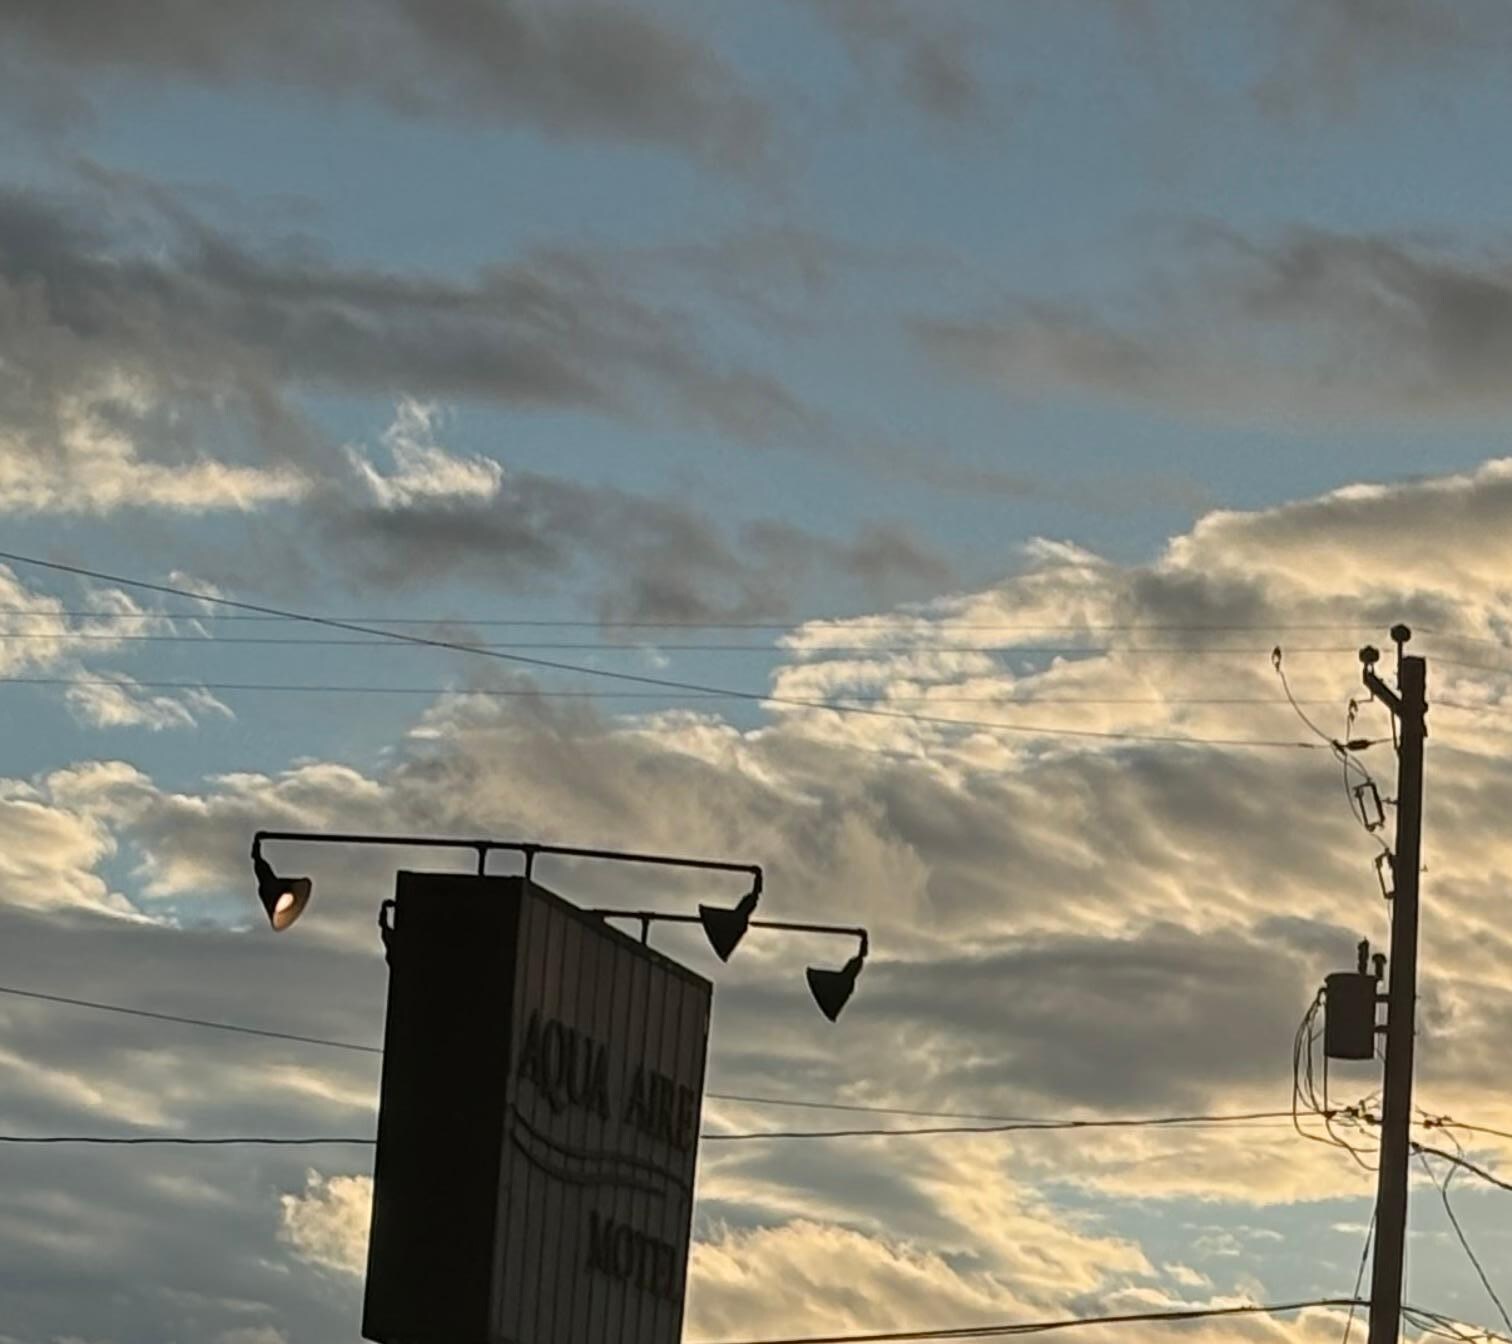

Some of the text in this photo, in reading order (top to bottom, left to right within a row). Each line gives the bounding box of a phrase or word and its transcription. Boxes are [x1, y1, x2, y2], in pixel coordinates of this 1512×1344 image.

[517, 1007, 694, 1153] AQUA AIRE
[585, 1209, 682, 1304] MOTEL
